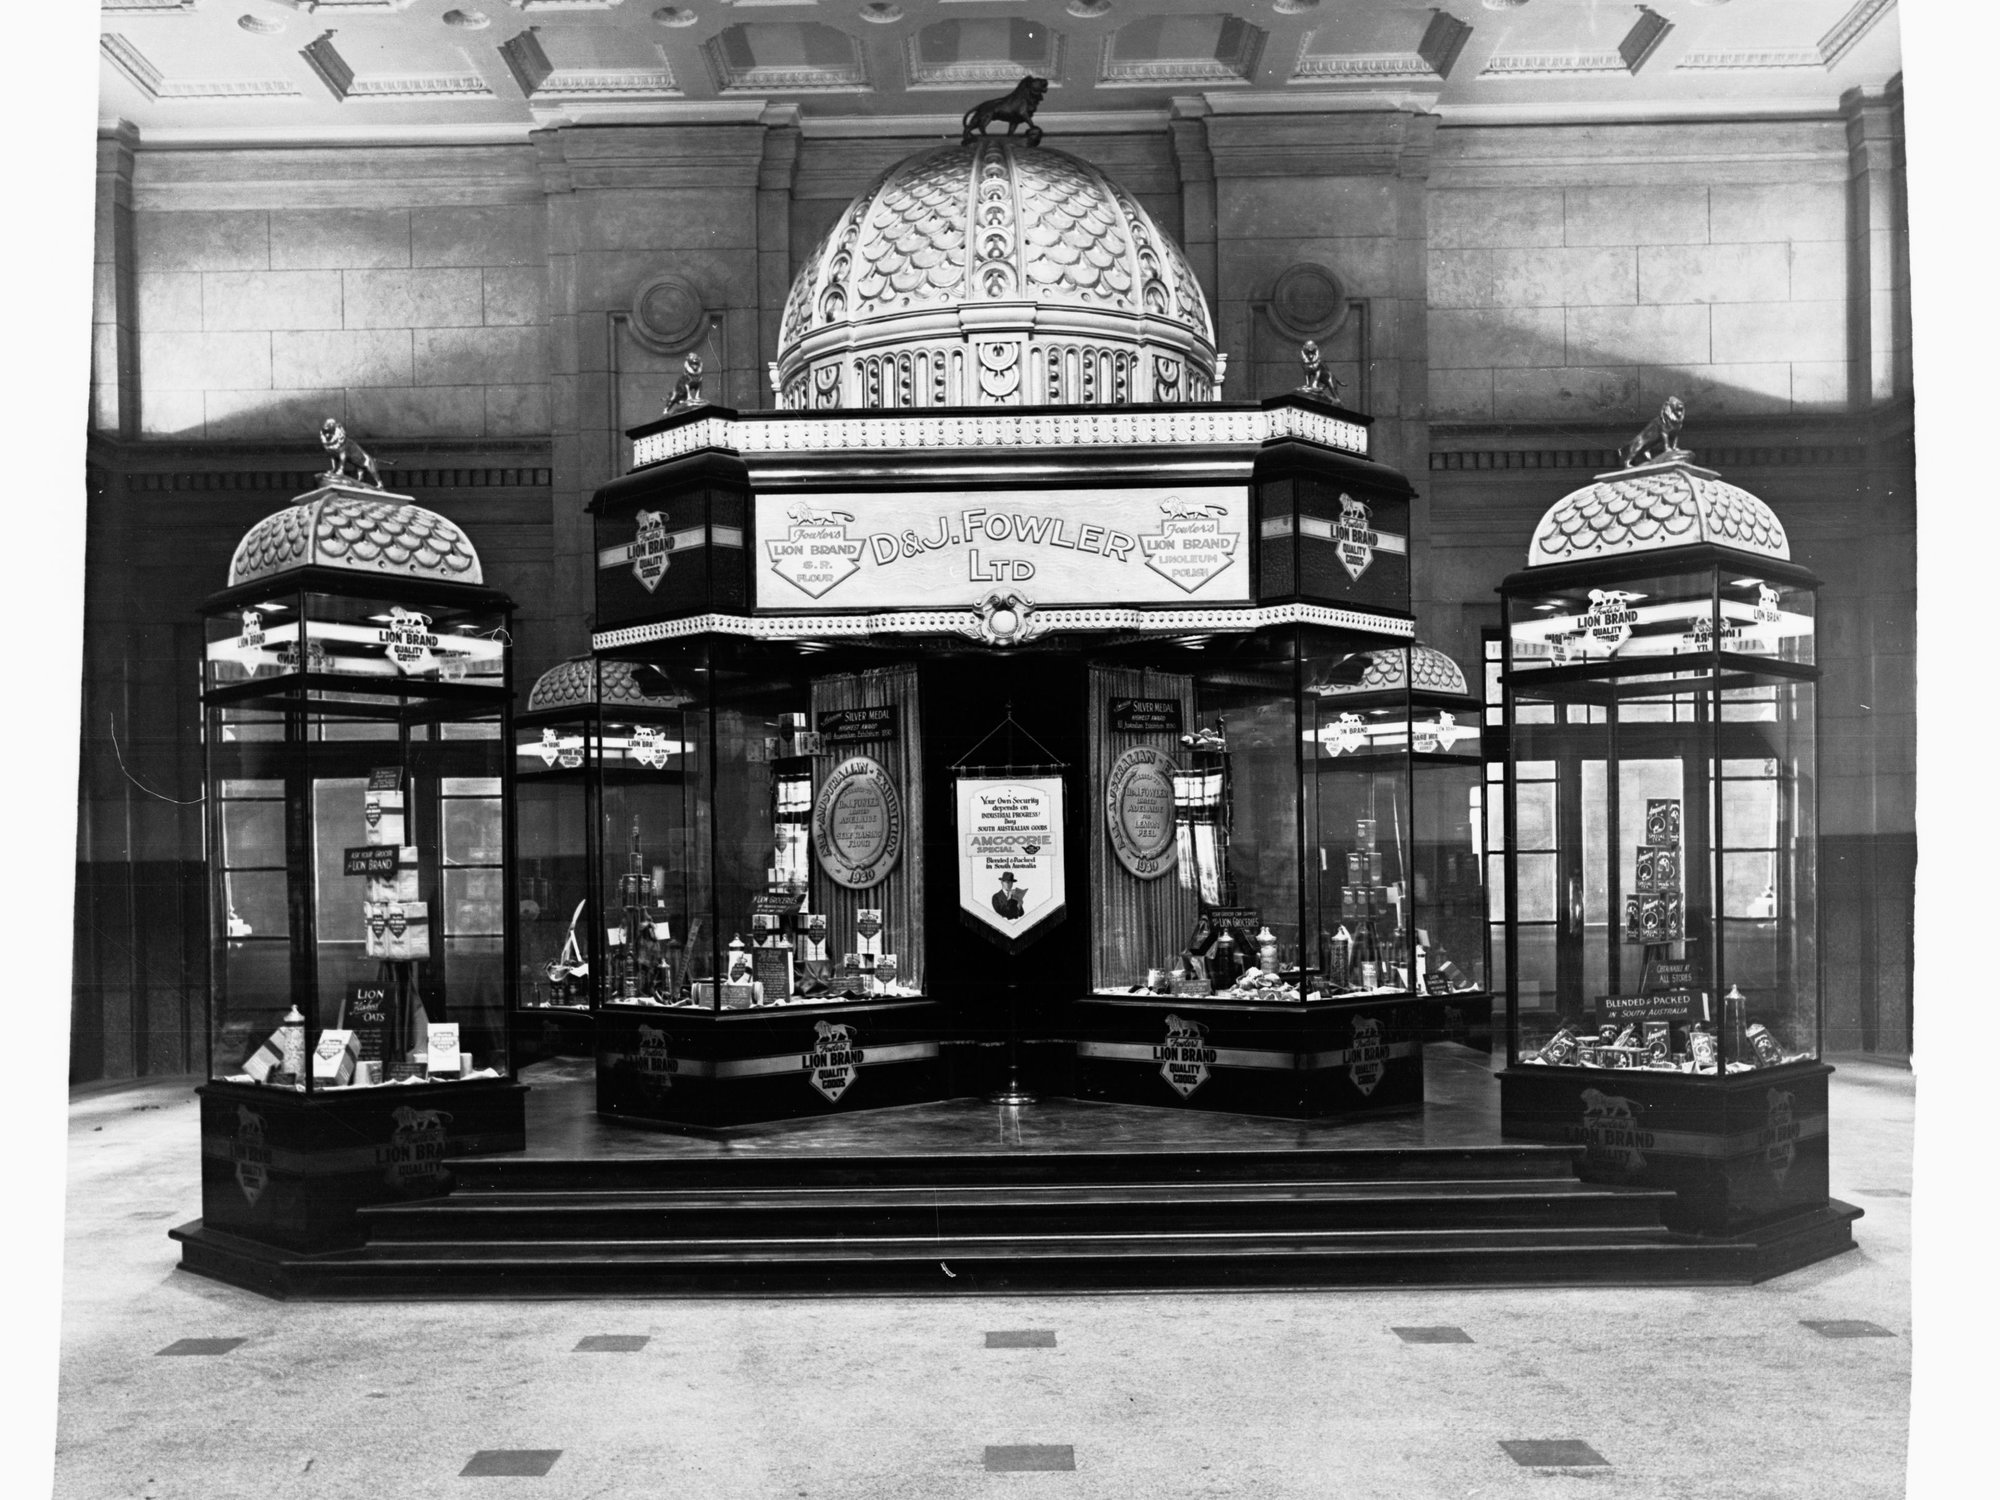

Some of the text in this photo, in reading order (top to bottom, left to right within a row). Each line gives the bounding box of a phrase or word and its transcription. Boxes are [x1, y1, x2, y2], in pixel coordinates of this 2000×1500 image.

[1330, 524, 1378, 547] LION BRAND
[627, 536, 675, 559] LION BRAND
[774, 544, 857, 555] LION BRAND
[1147, 538, 1230, 550] LION BRAND
[1342, 543, 1367, 556] QUALITY
[640, 555, 662, 568] QUALITY
[1159, 554, 1218, 564] LINOLEUM
[1345, 555, 1364, 567] GOODS
[969, 549, 1036, 582] LTD
[642, 566, 660, 578] GOODS
[796, 574, 834, 582] FLOUR
[1172, 568, 1209, 577] POLISH
[1577, 610, 1638, 629] LION BRAND
[1593, 626, 1622, 636] QUALITY
[379, 630, 438, 647] LION BRAND
[394, 645, 423, 654] QUALITY
[1133, 700, 1153, 713] SILVER
[1154, 702, 1175, 713] MEDAL
[844, 711, 867, 722] SILVER
[869, 710, 890, 720] MEDAL
[981, 796, 1039, 806] Your Own Security
[353, 859, 392, 871] LION BRAND
[1135, 859, 1159, 873] 1930
[847, 869, 875, 884] 1930
[357, 988, 385, 999] LION
[1606, 998, 1645, 1008] BLENDED
[1653, 995, 1691, 1006] PACKED
[363, 1012, 386, 1022] OATS
[1621, 1008, 1646, 1018] SOUTH
[1648, 1007, 1688, 1016] AUSTRALIA
[802, 1050, 864, 1069] LION BRAND
[1153, 1046, 1217, 1063] LION BRAND
[1343, 1046, 1390, 1064] LION BRAND
[651, 1057, 679, 1073] BRAND
[1169, 1063, 1201, 1075] QUALITY
[818, 1068, 848, 1080] QUALITY
[1173, 1074, 1197, 1085] GOODS
[822, 1078, 846, 1089] GOODS
[1604, 1130, 1655, 1148] BRAND
[376, 1147, 410, 1164] LION
